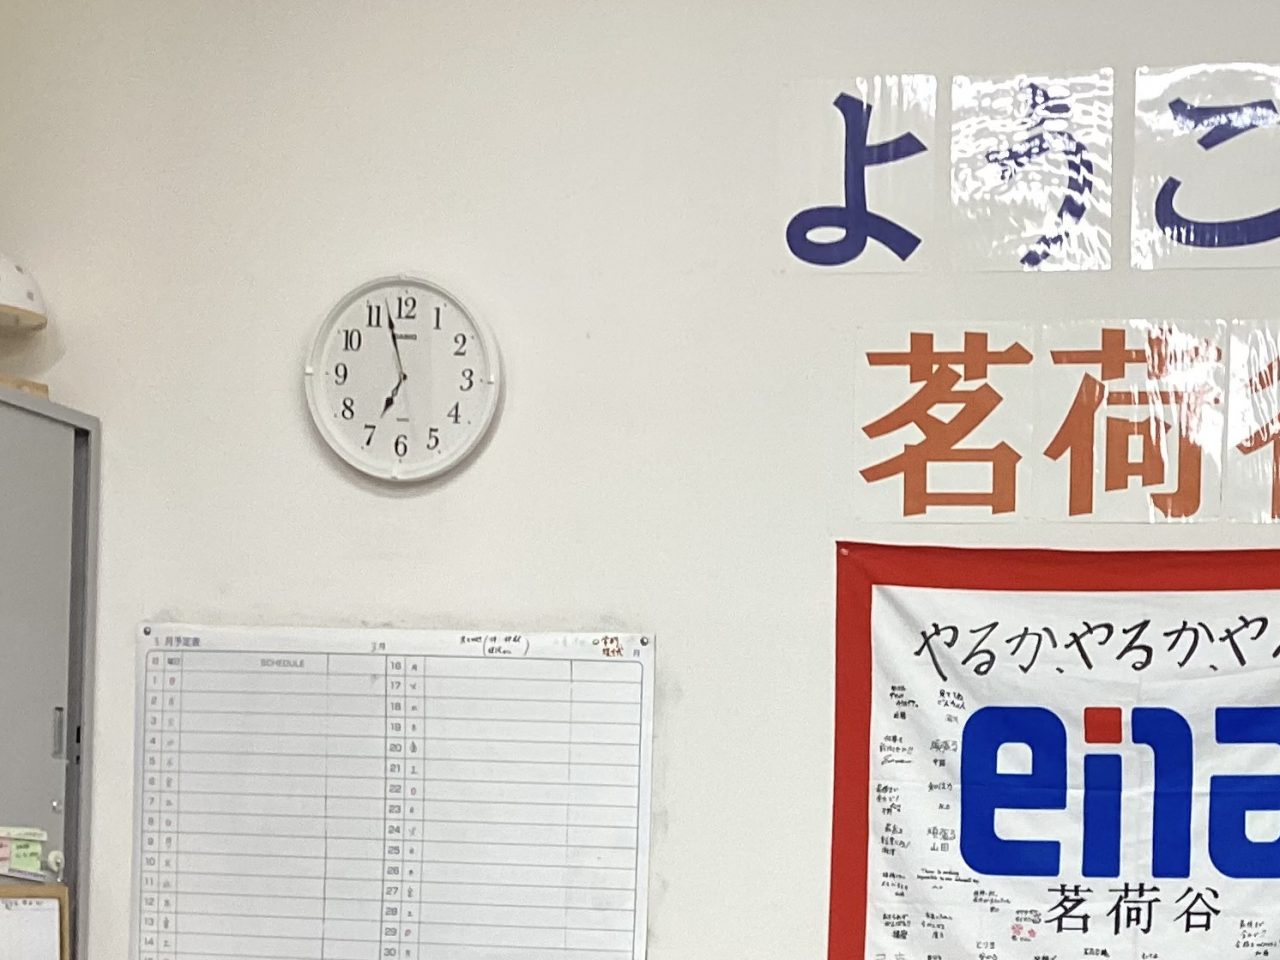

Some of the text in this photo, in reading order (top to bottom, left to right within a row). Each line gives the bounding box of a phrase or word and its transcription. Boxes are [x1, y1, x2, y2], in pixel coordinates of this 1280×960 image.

[367, 304, 382, 328] 11
[397, 297, 417, 319] 12
[434, 307, 442, 330] 1
[342, 329, 362, 351] 10
[453, 333, 466, 356] 2
[334, 363, 347, 385] 9
[459, 368, 473, 391] 3
[341, 397, 354, 419] 8
[447, 402, 461, 424] 4
[363, 424, 376, 446] 7
[394, 434, 407, 457] 6
[426, 428, 439, 450] 5
[260, 658, 305, 668] SCHEDULE
[1044, 882, 1221, 936] 茗荷谷
